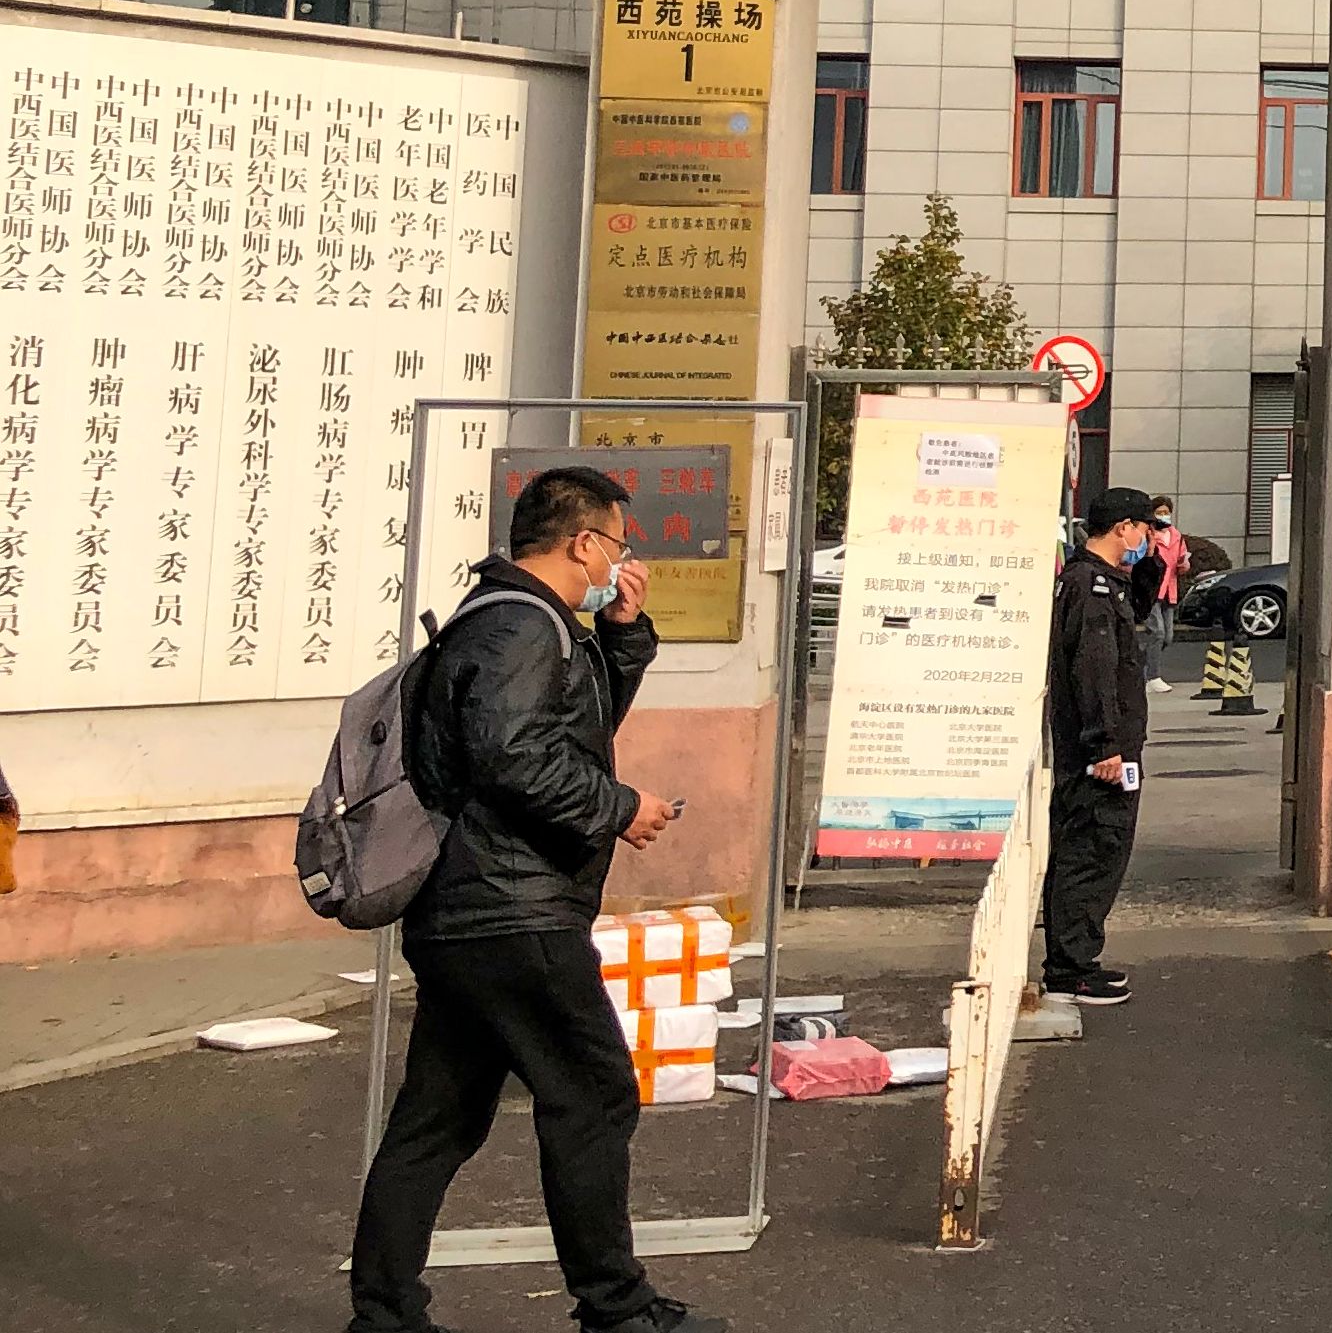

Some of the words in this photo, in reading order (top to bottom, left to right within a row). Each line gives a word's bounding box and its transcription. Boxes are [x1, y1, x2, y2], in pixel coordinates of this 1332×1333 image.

[626, 29, 749, 44] XIYUANCAOCHANG
[680, 43, 695, 82] 1
[0, 67, 44, 291] 中西医结合医师分会
[36, 71, 80, 293] 中国医师协会
[81, 75, 125, 295] 中西医结合医师分会
[118, 79, 160, 296] 中国医师协会
[162, 83, 204, 299] 中西医结合医师分会
[197, 86, 238, 301] 中国医师协会
[240, 90, 279, 302] 中西医结合医师分会
[273, 94, 312, 304] 中国医师协会
[314, 98, 352, 307] 中西医结合医师分会
[347, 101, 383, 308] 中国医师协会
[386, 105, 424, 309] 老年医学学会
[417, 108, 453, 309] 中国老年学和
[455, 112, 492, 313] 医药学会
[484, 114, 520, 315] 中国民族
[608, 244, 747, 269] 定点医疗机构
[646, 217, 752, 231] 北京市基本医疗保险
[0, 335, 45, 676] 消化病学专家委员会
[68, 337, 126, 673] 肿瘤病学专家委员会
[148, 340, 205, 669] 肝病学专家委员会
[226, 343, 281, 667] 泌尿外科学专家委员会
[301, 347, 354, 664] 肛肠病学专家委员会
[596, 432, 665, 446] 北京市
[888, 514, 1021, 538] 暂停发热门诊
[913, 488, 999, 508] 西苑医院
[923, 669, 1023, 684] 2020年2月22日
